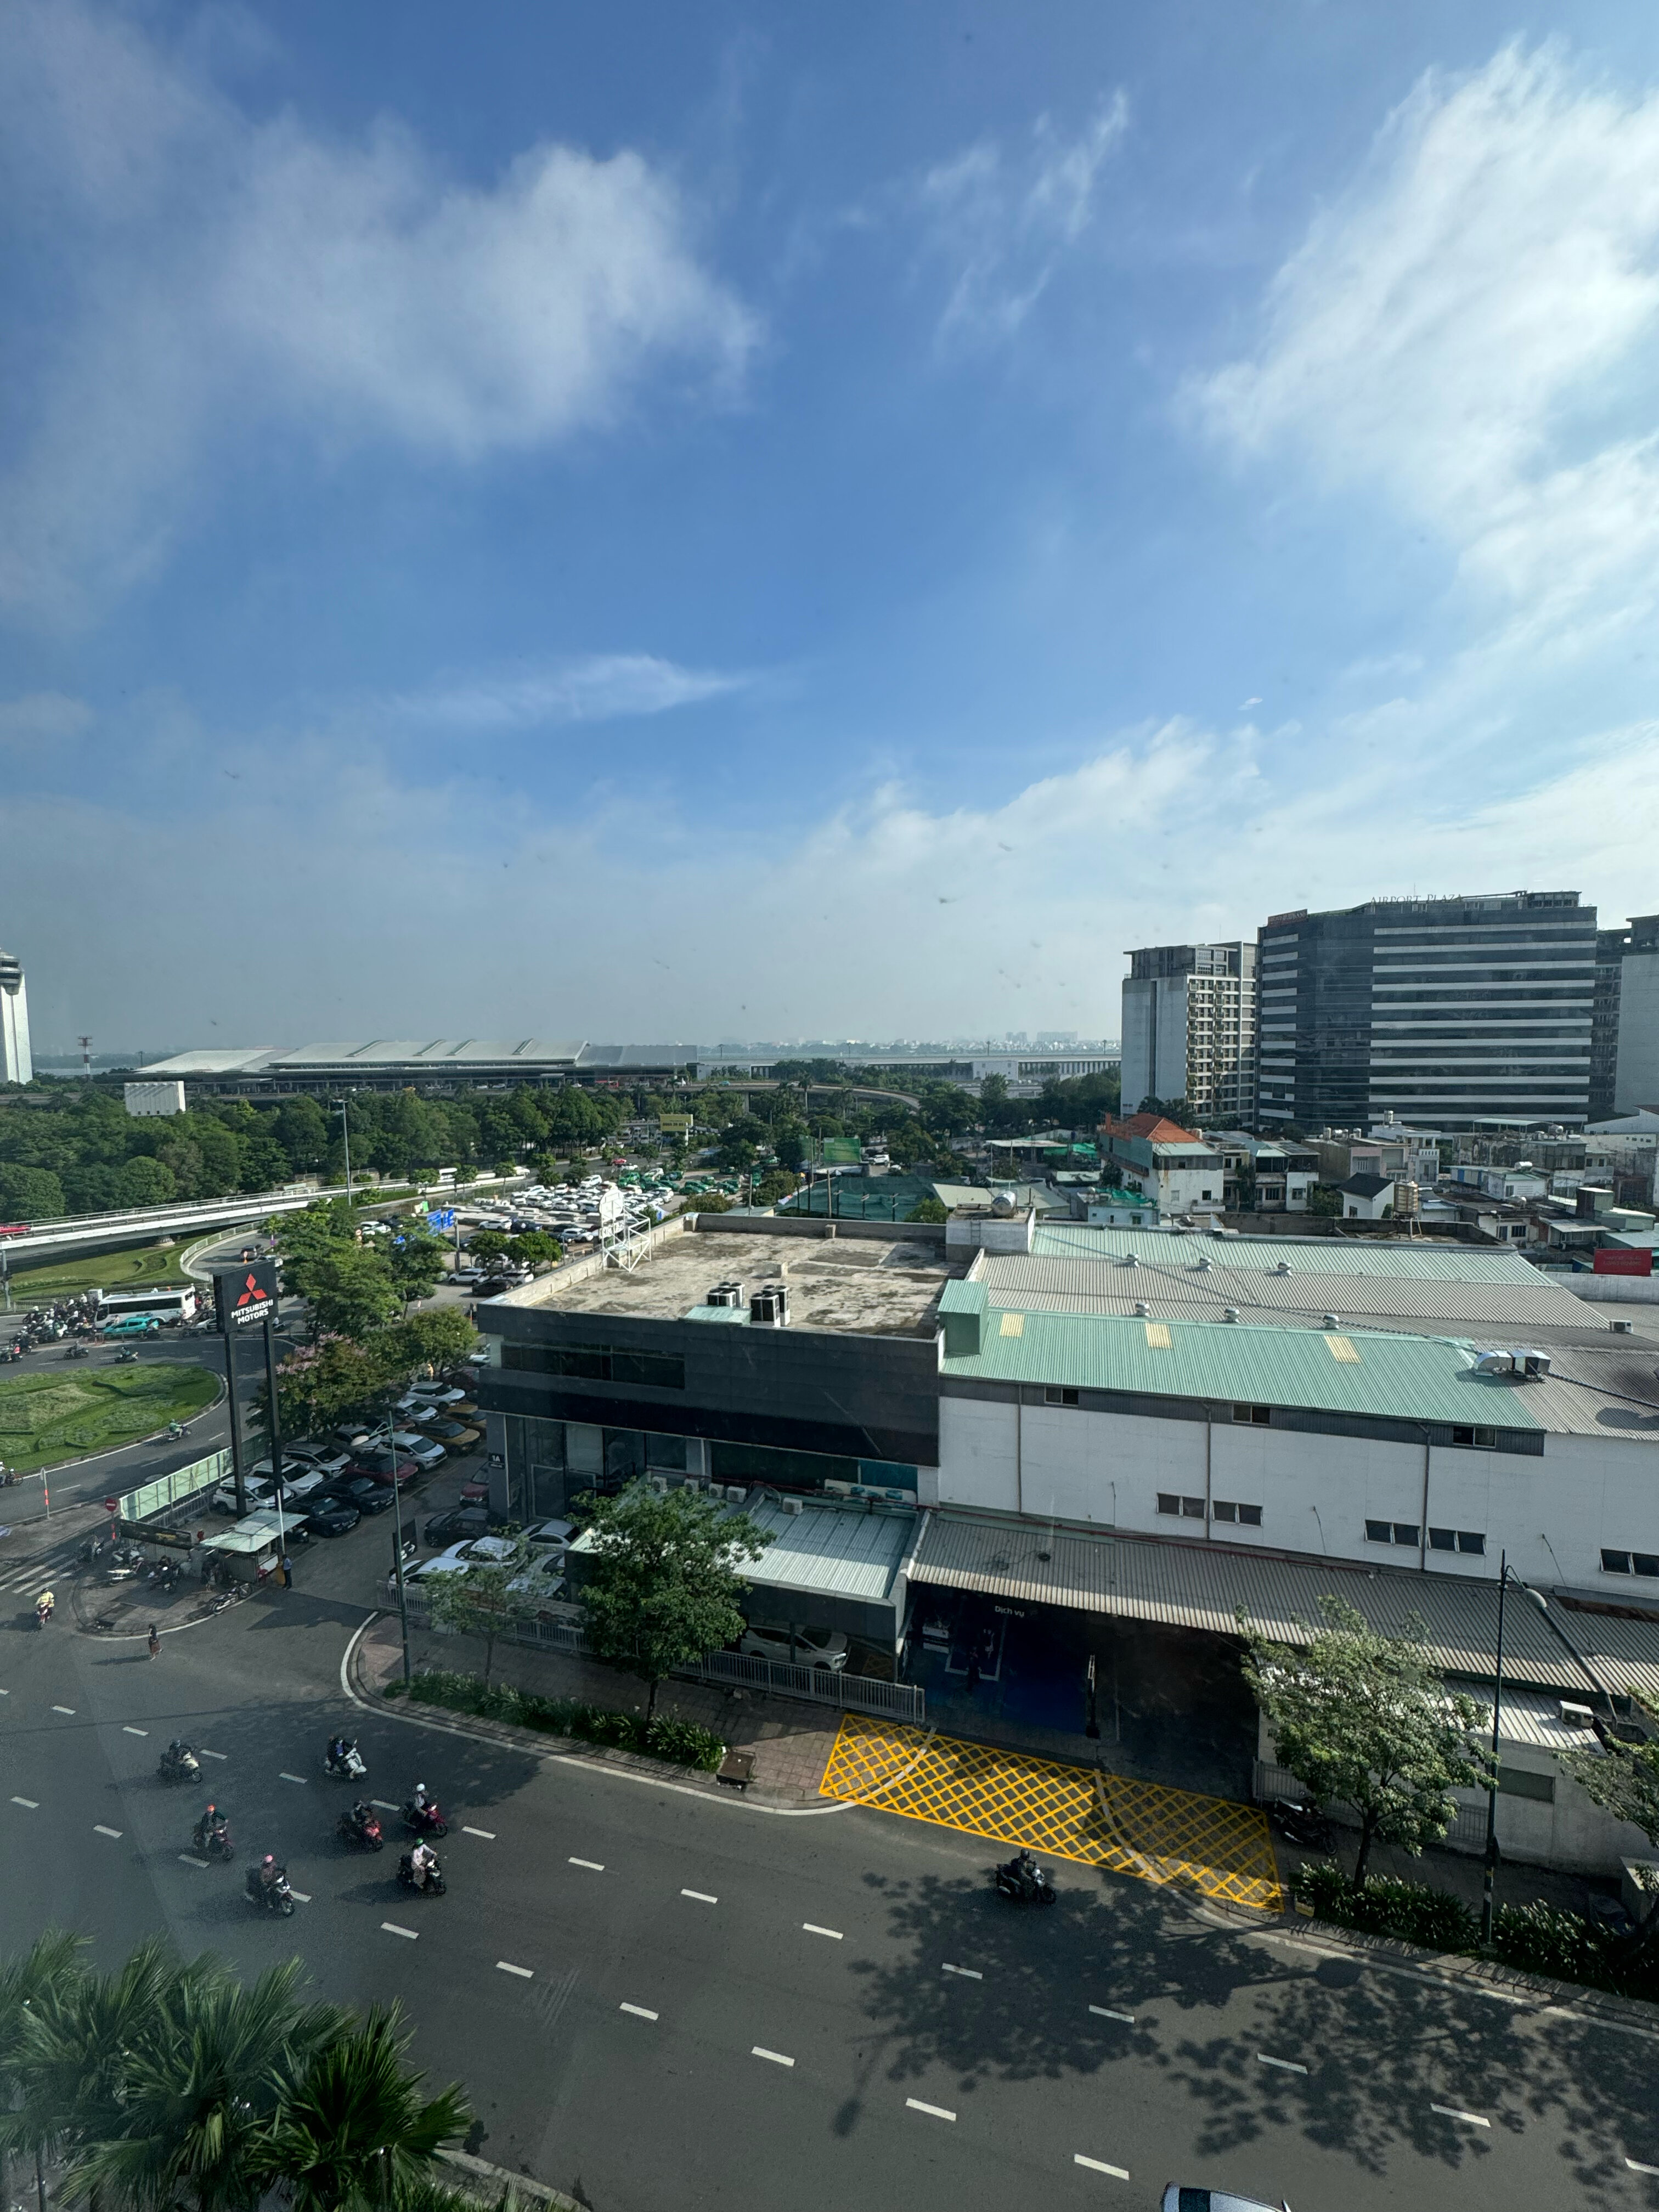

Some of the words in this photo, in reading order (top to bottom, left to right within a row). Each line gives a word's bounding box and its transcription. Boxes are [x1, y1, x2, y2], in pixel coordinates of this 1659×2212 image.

[1370, 895, 1421, 905] AIRPORT
[1426, 893, 1462, 904] PLAZA
[231, 1299, 273, 1318] MITSUBISHI
[238, 1308, 269, 1324] MOTORS
